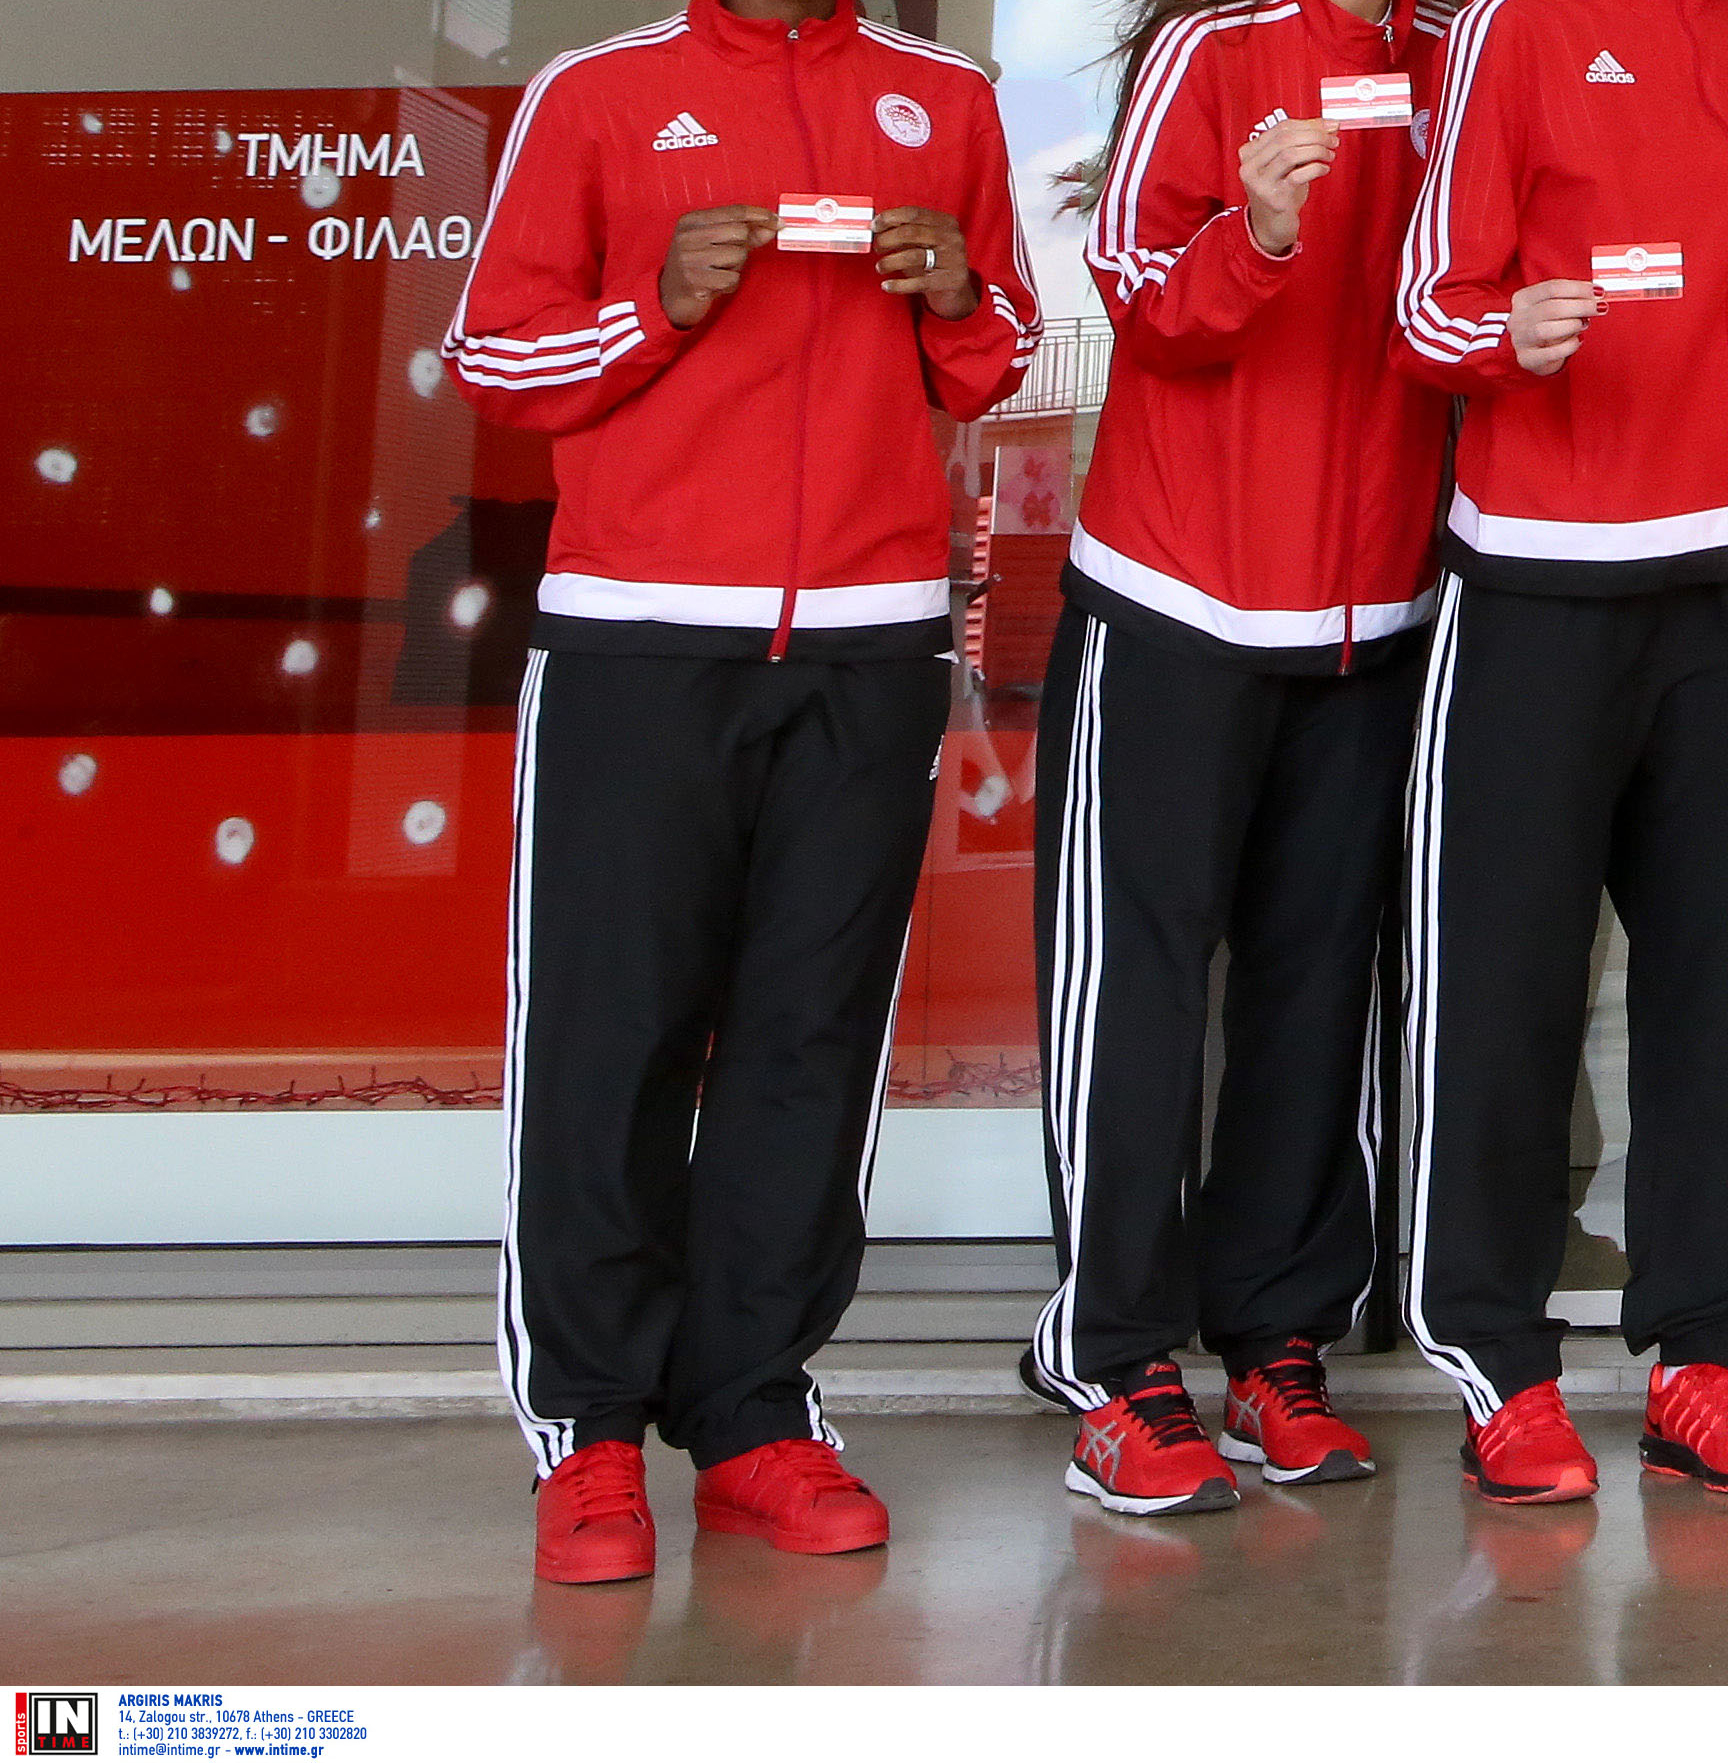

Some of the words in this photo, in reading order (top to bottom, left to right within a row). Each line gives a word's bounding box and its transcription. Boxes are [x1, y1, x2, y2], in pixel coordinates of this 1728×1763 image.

[1586, 70, 1635, 83] adidas
[238, 134, 425, 176] ΤΜΗΜΑ
[653, 134, 718, 150] adidas
[69, 217, 256, 262] ΜΕΛΩΝ
[308, 215, 479, 260] ΦΙΛΑΘ
